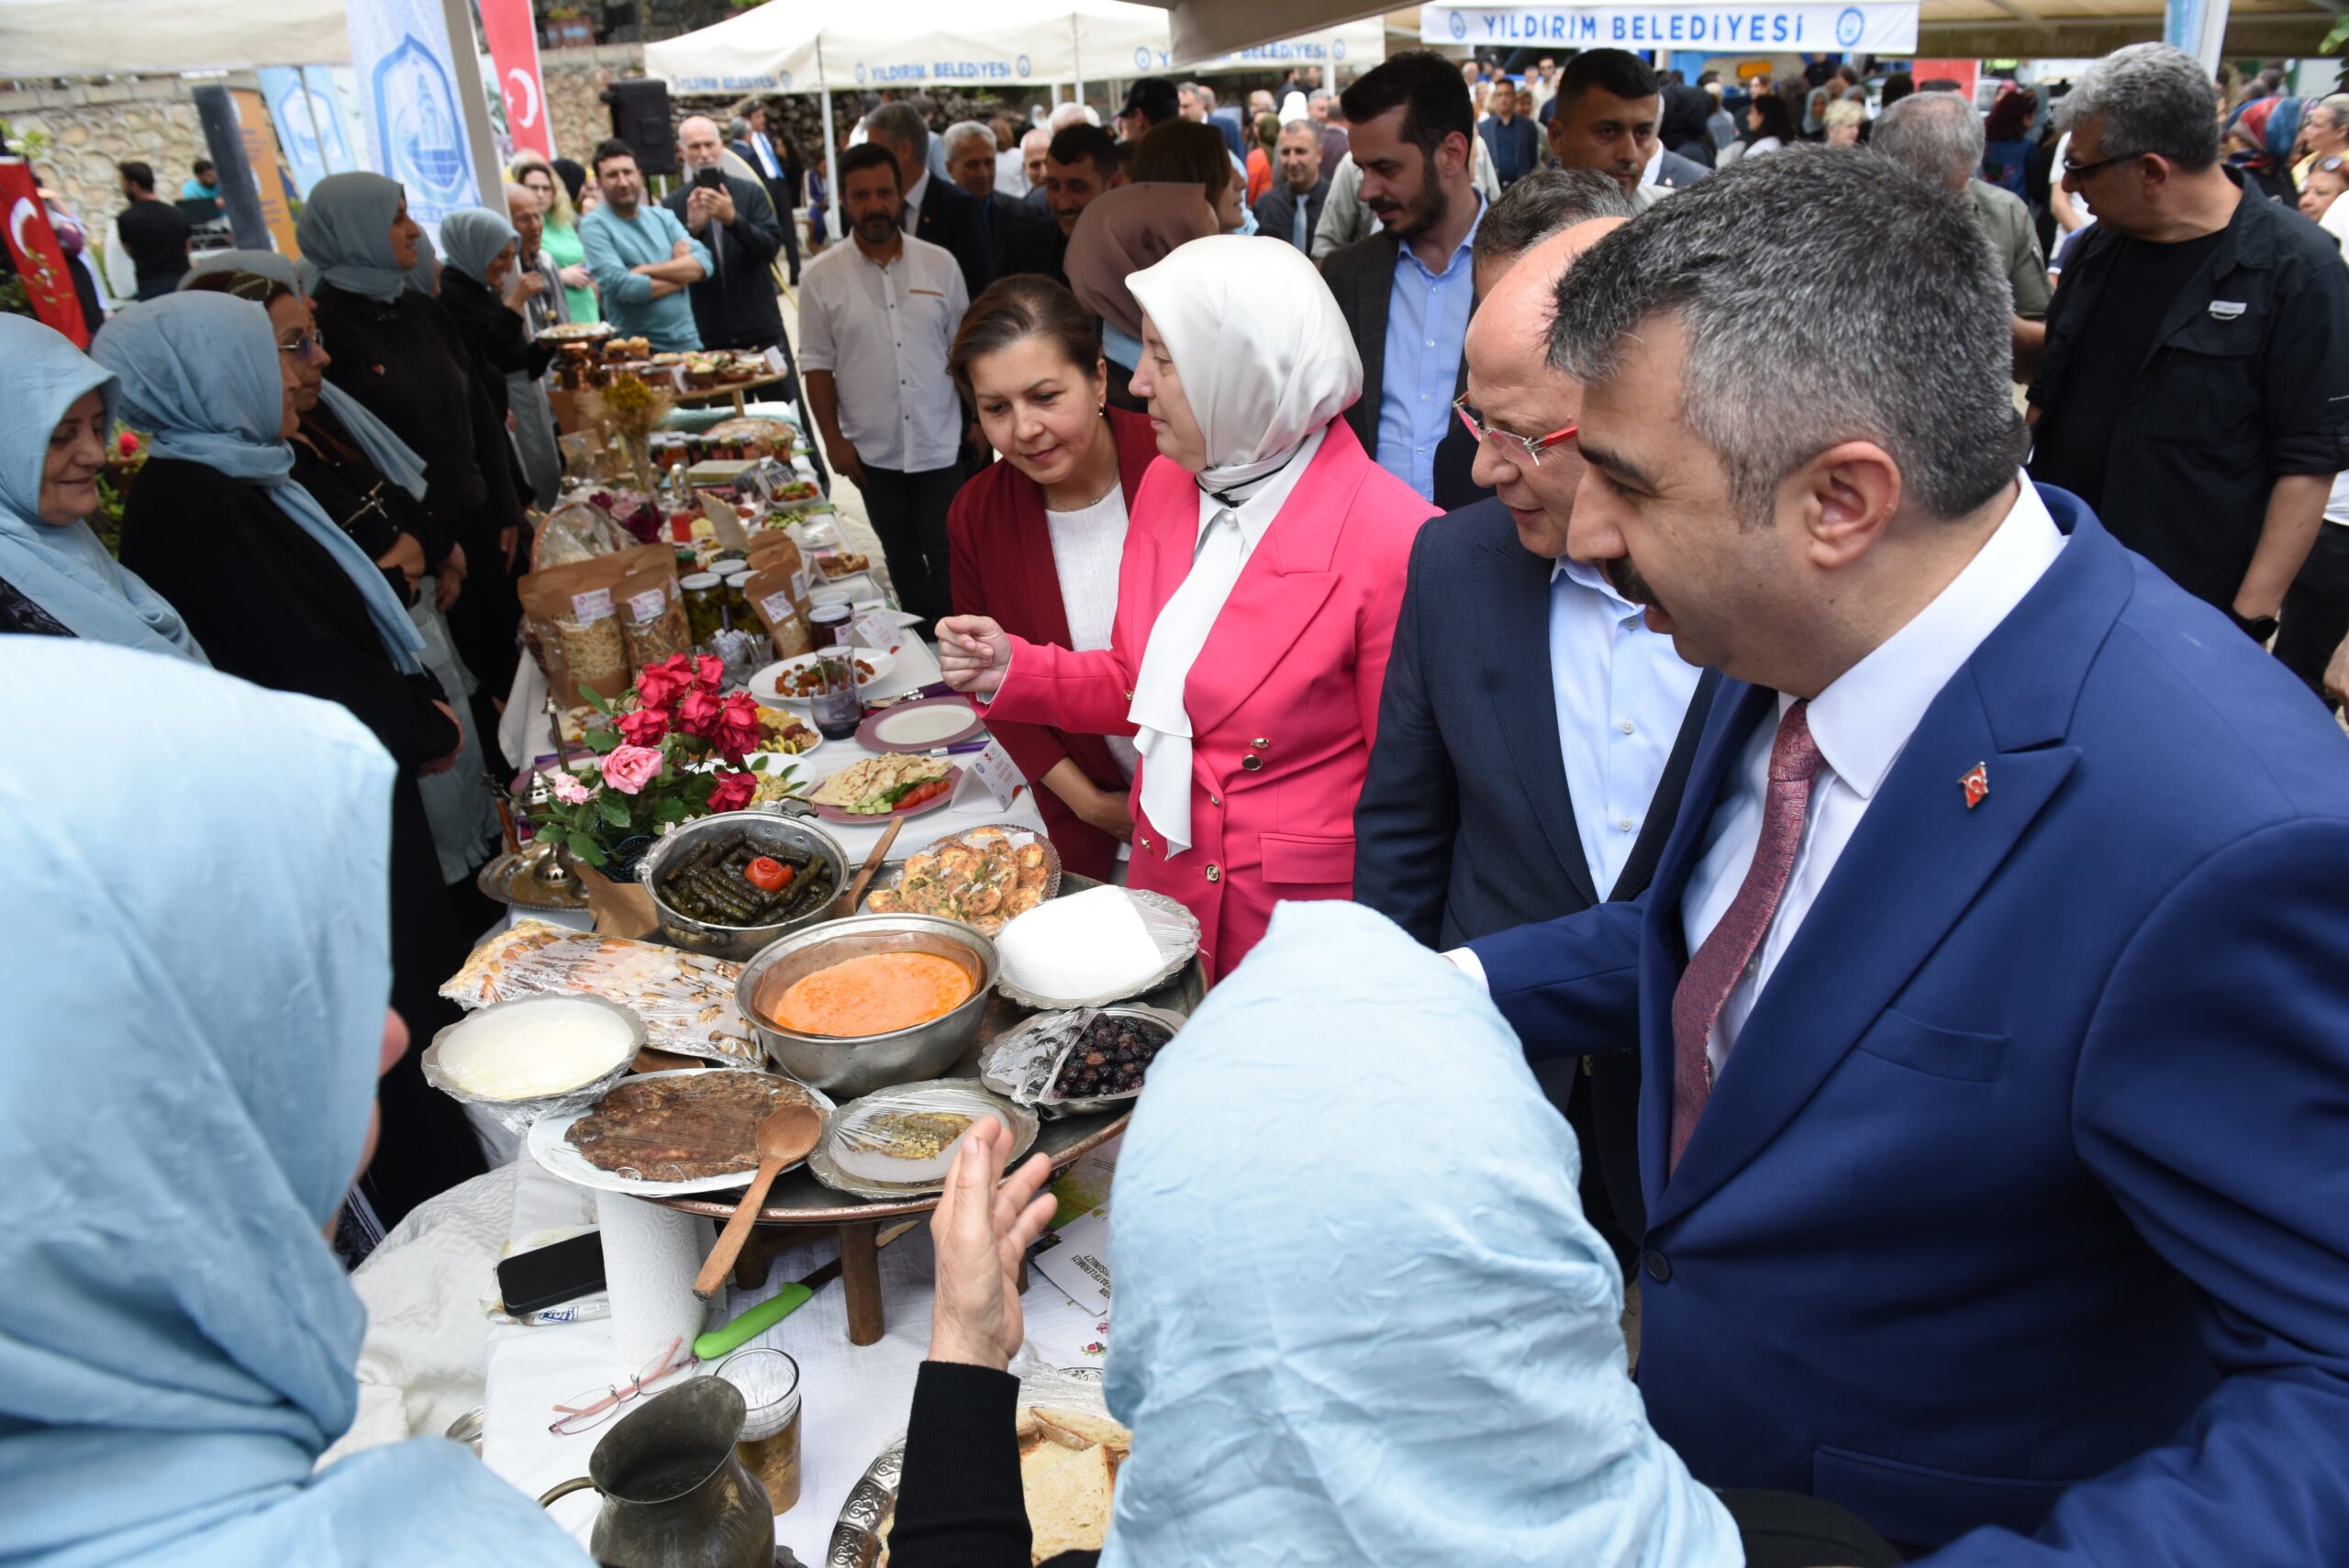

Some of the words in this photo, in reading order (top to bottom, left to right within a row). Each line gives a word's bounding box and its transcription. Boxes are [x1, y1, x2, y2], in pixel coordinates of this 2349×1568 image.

[1483, 14, 1597, 39] YILDIRIM
[1612, 14, 1804, 41] BELEDİYESİ
[871, 63, 926, 81] YILDIRIM
